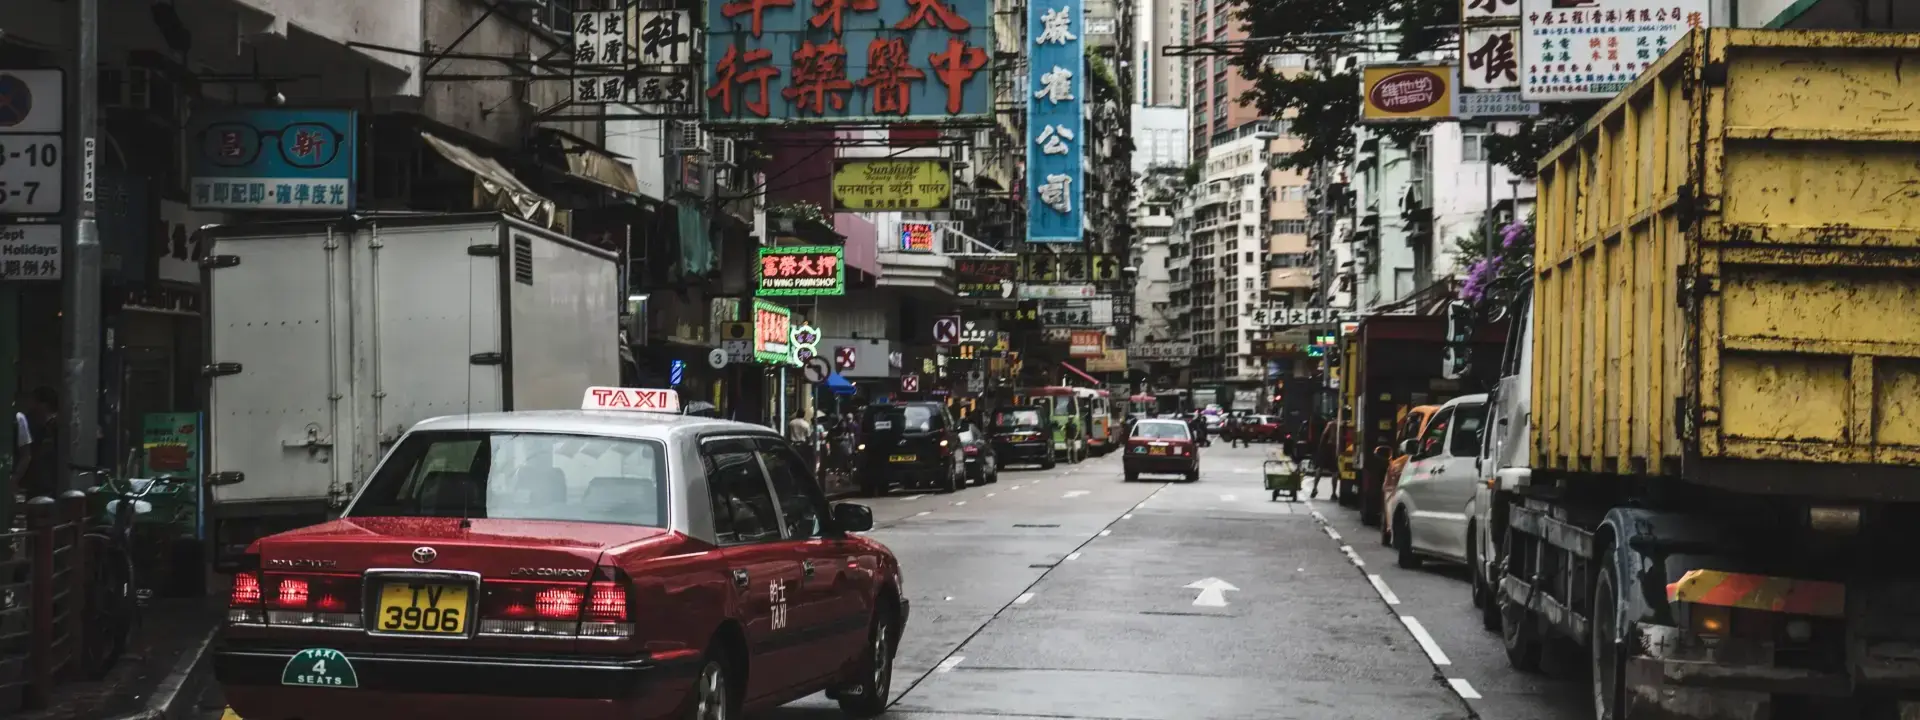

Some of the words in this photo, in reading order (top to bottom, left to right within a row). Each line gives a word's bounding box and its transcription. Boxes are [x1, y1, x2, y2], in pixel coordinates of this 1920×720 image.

[1529, 7, 1681, 25] 中原工程(香港)有限公司
[705, 37, 990, 117] 中醫藥行
[863, 162, 919, 176] Sunshine
[3, 244, 58, 256] Holidays
[0, 260, 57, 277] 期例外
[761, 255, 837, 277] 富榮大押
[762, 278, 772, 287] FU
[773, 278, 793, 287] WING
[794, 278, 836, 287] PAWNSHOP
[592, 389, 667, 408] TAXI
[536, 568, 590, 578] COMFORT
[408, 585, 445, 608] TV
[769, 578, 786, 602] 的士
[384, 607, 460, 632] 3906
[770, 603, 787, 630] TAXI
[305, 649, 337, 660] TAXI
[311, 659, 327, 674] 4
[297, 675, 342, 686] SEATS
